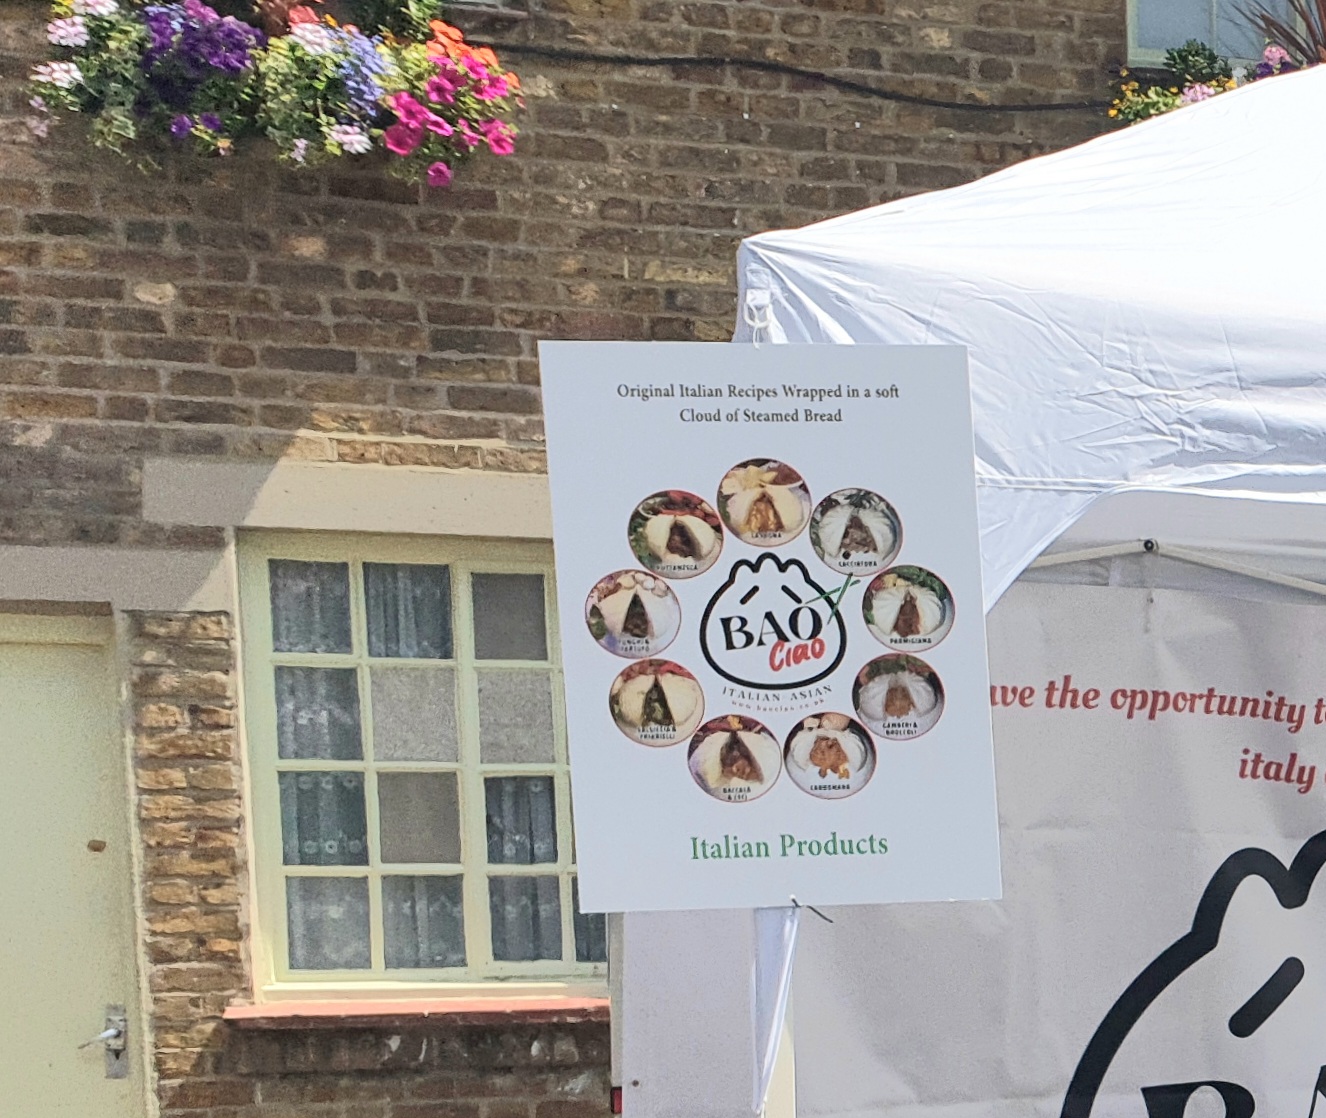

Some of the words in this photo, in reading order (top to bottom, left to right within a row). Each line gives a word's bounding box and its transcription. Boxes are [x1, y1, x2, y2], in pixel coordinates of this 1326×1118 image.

[617, 384, 675, 401] Original
[679, 384, 723, 398] Italian
[728, 385, 778, 401] Recipes
[782, 384, 842, 402] Wrapped
[847, 384, 859, 398] in
[864, 388, 871, 398] a
[875, 384, 899, 398] soft
[680, 409, 721, 422] Cloud
[726, 409, 739, 422] of
[743, 409, 799, 422] Steamed
[804, 409, 842, 422] Bread
[720, 606, 823, 651] BAO
[769, 637, 826, 672] Ciao
[722, 686, 780, 701] ITALIAN
[790, 685, 833, 701] ASIAN
[1044, 675, 1100, 709] the
[1110, 687, 1306, 733] opportunity
[1239, 748, 1316, 794] italy
[690, 834, 770, 860] Italian
[780, 831, 889, 857] Products
